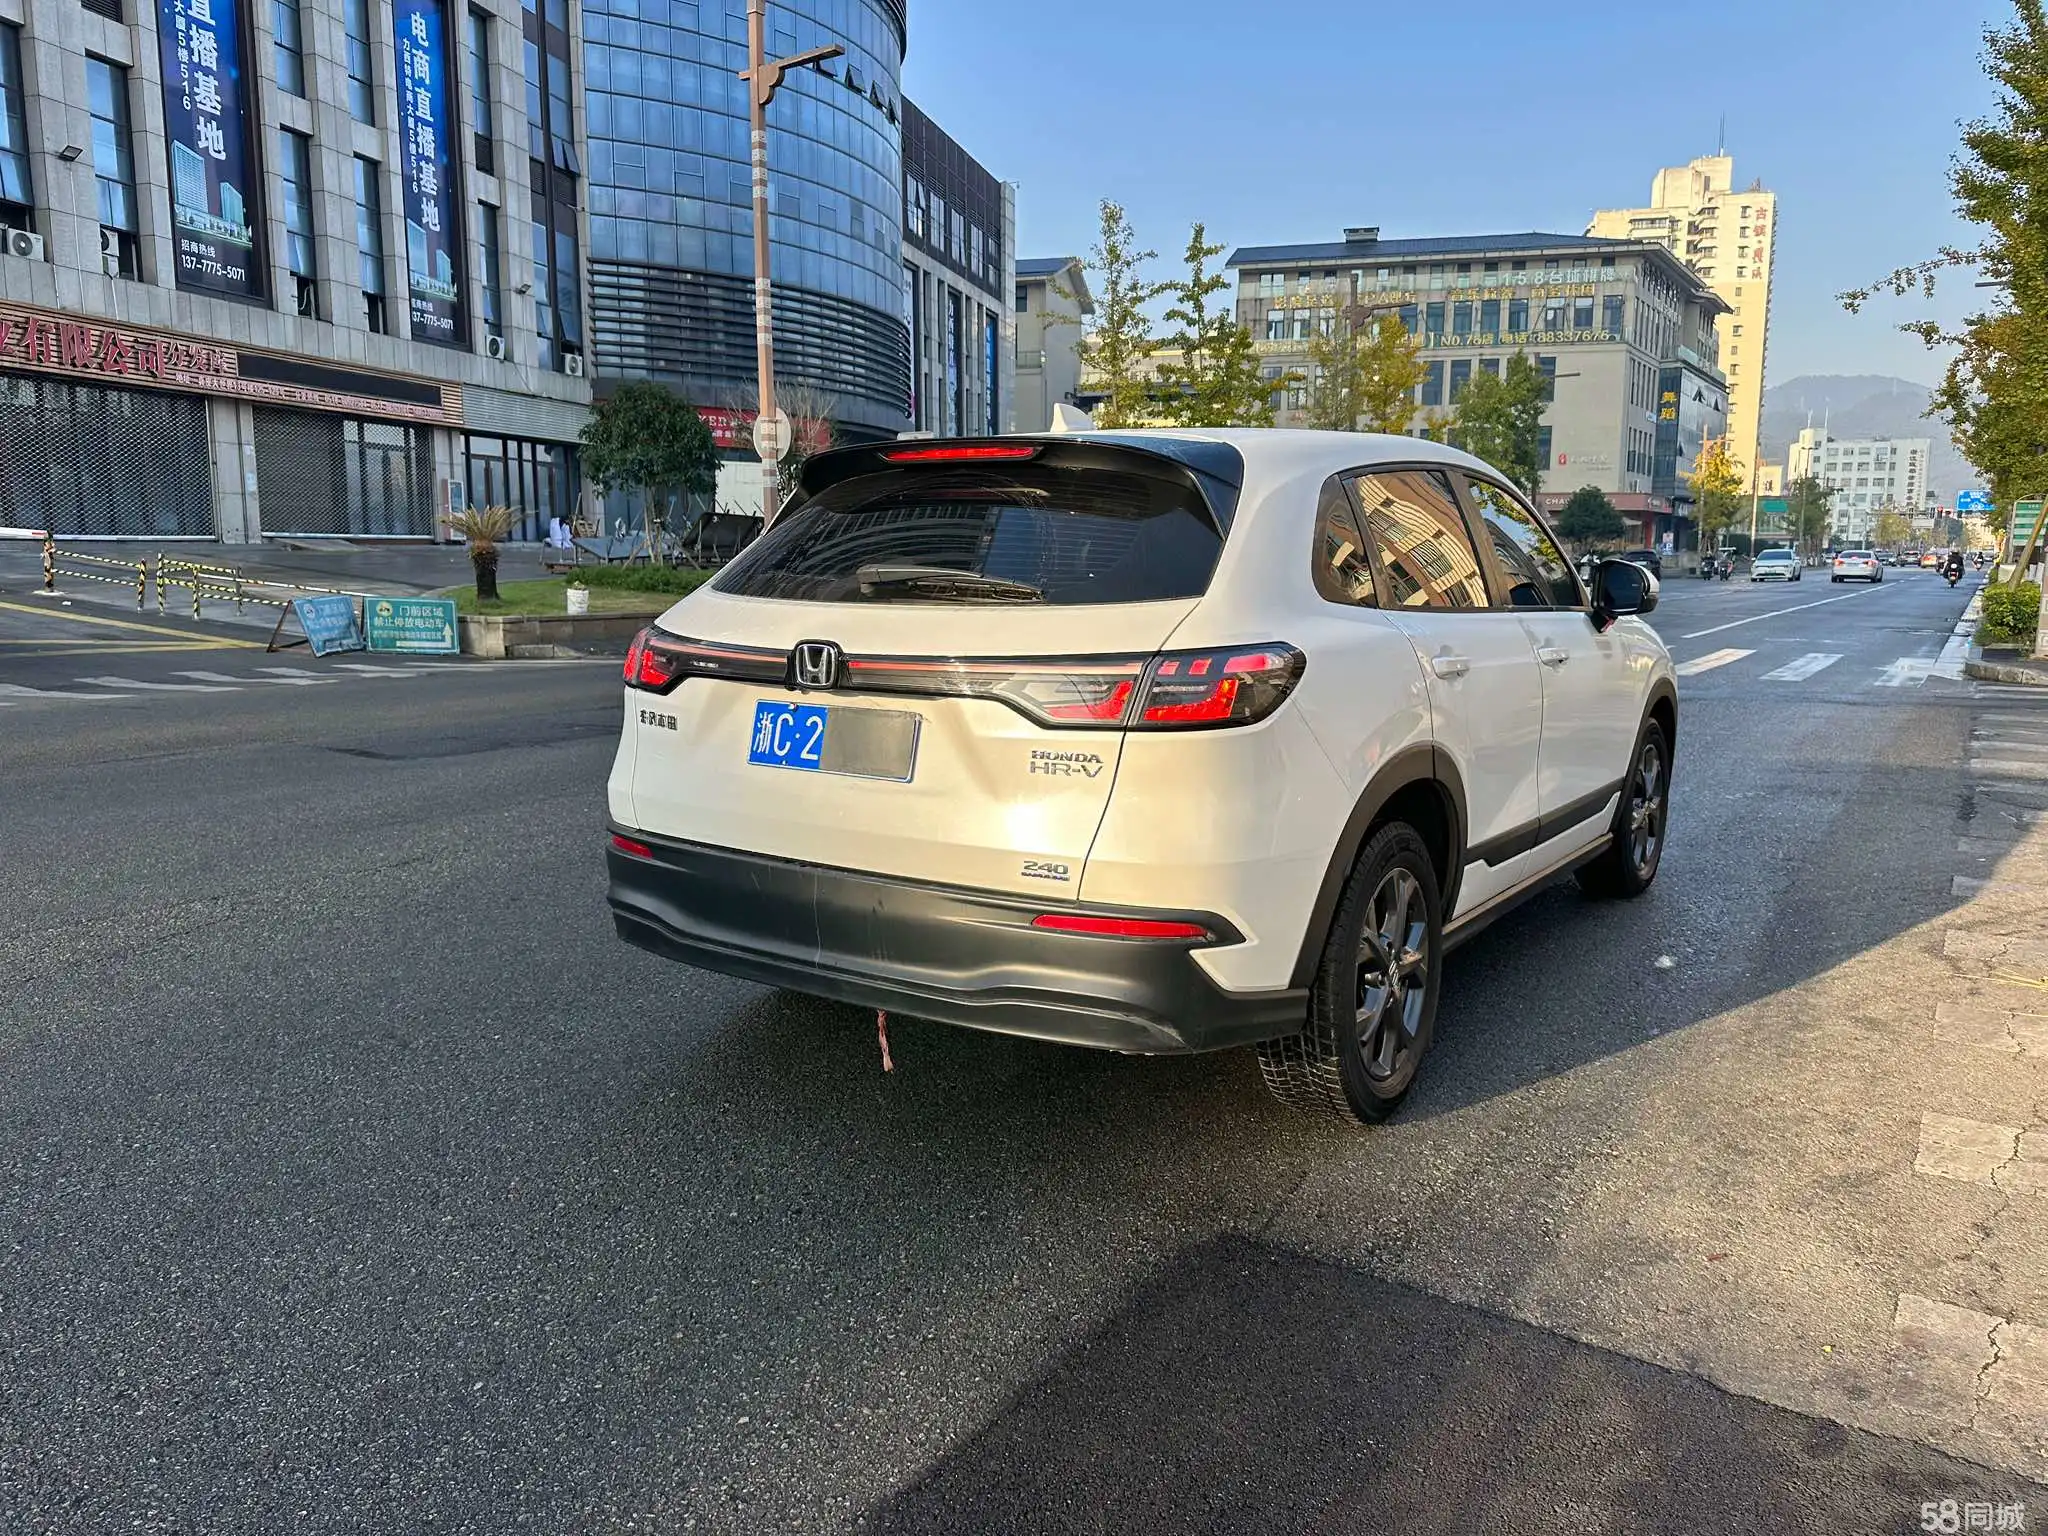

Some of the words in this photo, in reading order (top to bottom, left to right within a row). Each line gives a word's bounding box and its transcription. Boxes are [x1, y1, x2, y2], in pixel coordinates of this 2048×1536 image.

[410, 11, 440, 232] 电商直播基地
[181, 238, 216, 257] 招商热线
[181, 254, 246, 281] 137-7775-5071
[399, 605, 445, 618] 门前区域
[373, 617, 445, 629] 禁止停放电动车
[640, 709, 678, 731] 东风本田
[1031, 750, 1104, 764] HONDA
[1030, 761, 1103, 778] HR-V
[1023, 860, 1069, 874] 240
